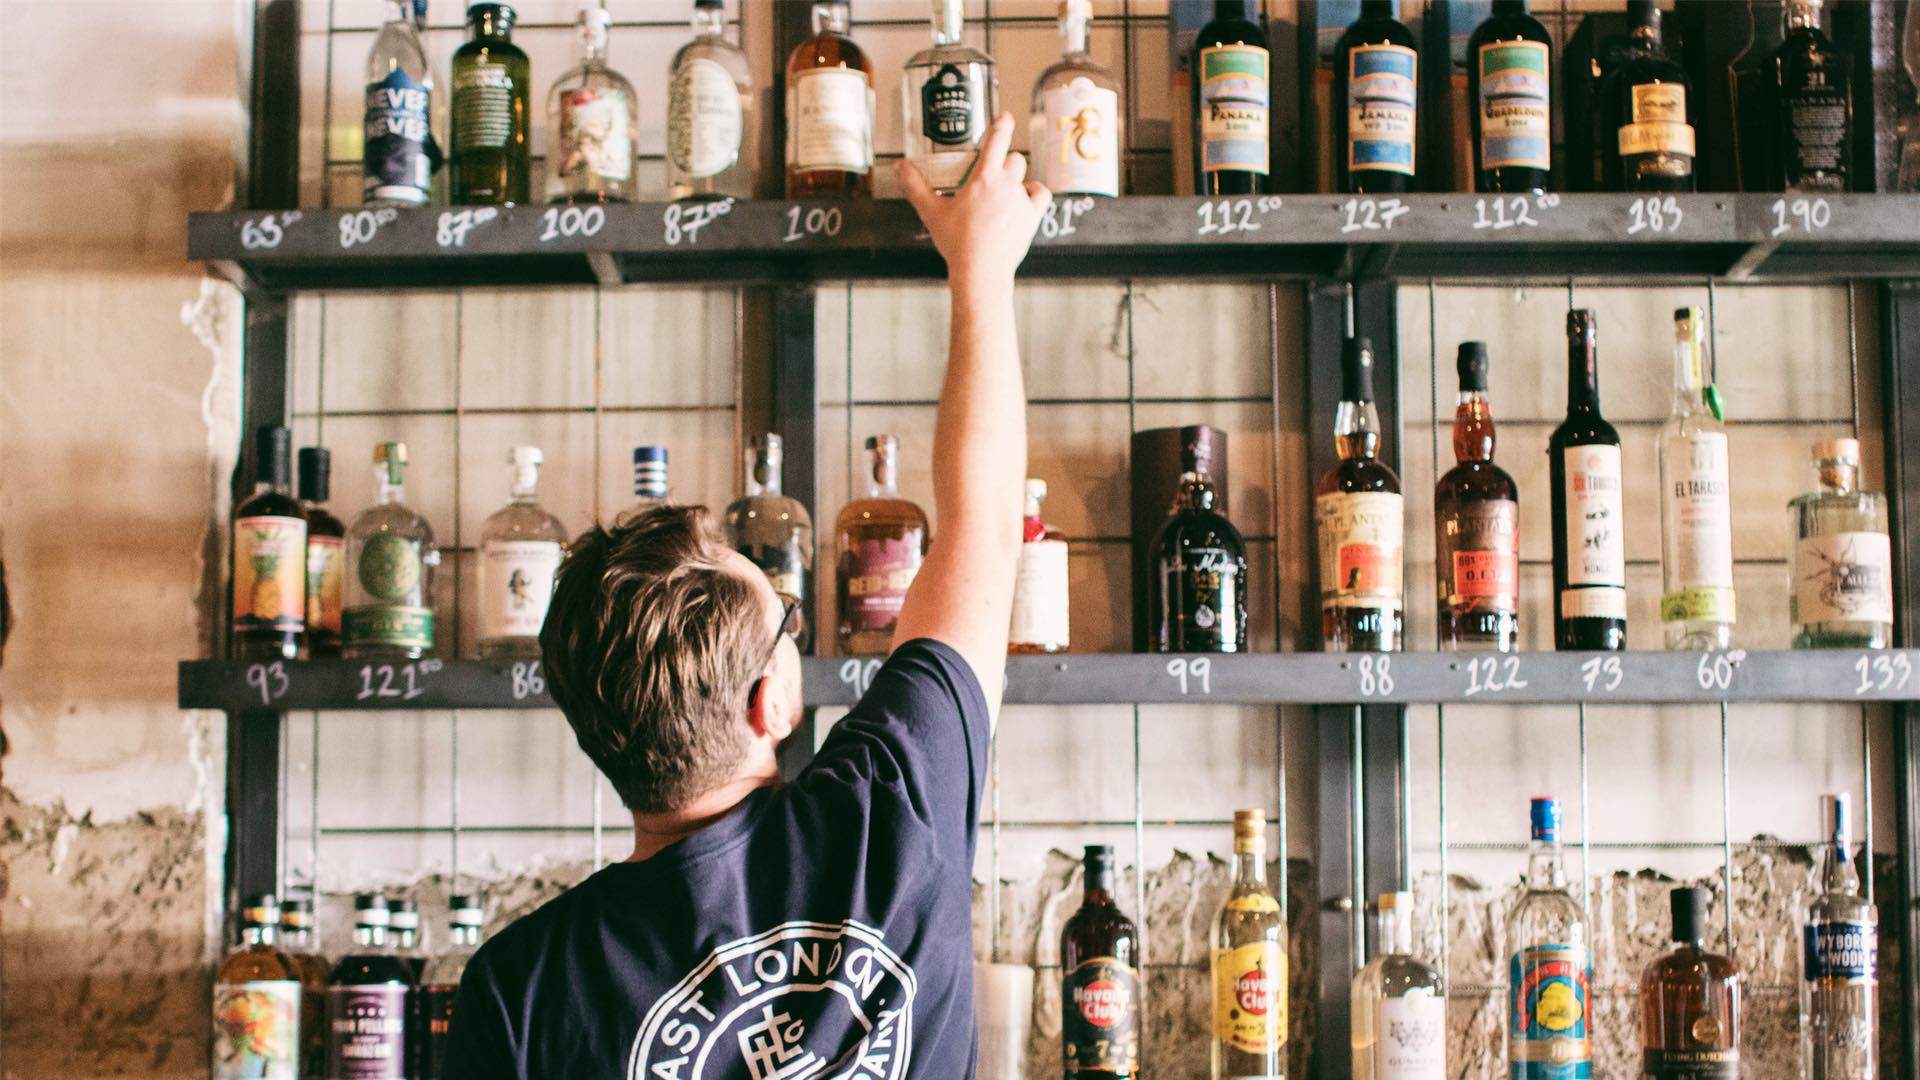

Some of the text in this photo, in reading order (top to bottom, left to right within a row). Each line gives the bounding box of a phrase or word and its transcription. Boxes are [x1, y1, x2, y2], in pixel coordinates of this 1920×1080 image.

[539, 205, 606, 242] 100
[783, 204, 843, 242] 100
[1341, 198, 1410, 235] 127
[1627, 197, 1684, 235] 183
[1771, 198, 1831, 237] 190
[246, 661, 289, 705] 93
[512, 660, 544, 700] 86
[1166, 656, 1211, 695] 99
[1358, 653, 1395, 696] 88
[1465, 655, 1528, 695] 122
[1581, 656, 1624, 692] 73
[1855, 651, 1913, 696] 133
